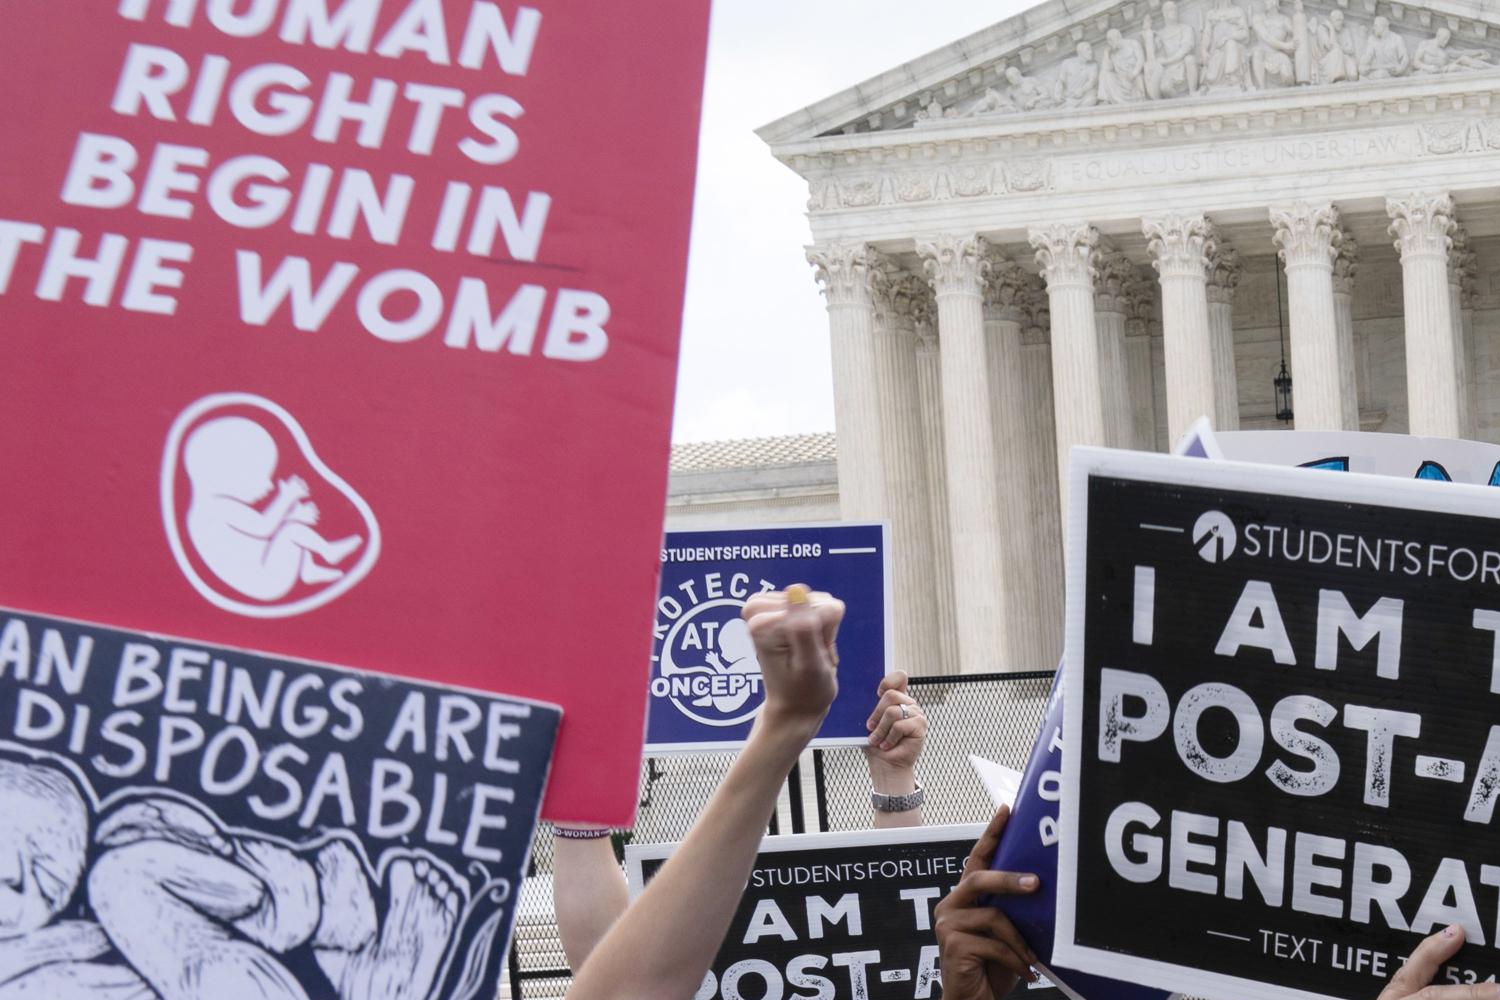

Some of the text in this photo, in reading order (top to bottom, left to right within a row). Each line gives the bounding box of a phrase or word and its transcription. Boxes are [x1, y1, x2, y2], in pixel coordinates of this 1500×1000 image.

[111, 43, 526, 165] RIGHTS
[60, 132, 551, 262] BEGIN IN
[236, 250, 611, 361] WOMB
[681, 621, 719, 651] AT
[1132, 565, 1156, 645] I
[1214, 580, 1404, 680] AM
[113, 643, 364, 741] BEINGS
[386, 691, 531, 773] ARE
[13, 689, 515, 862] DISPOSABLE
[743, 893, 863, 944] AM
[1258, 929, 1323, 966] TEXT
[1330, 943, 1388, 978] LIFE
